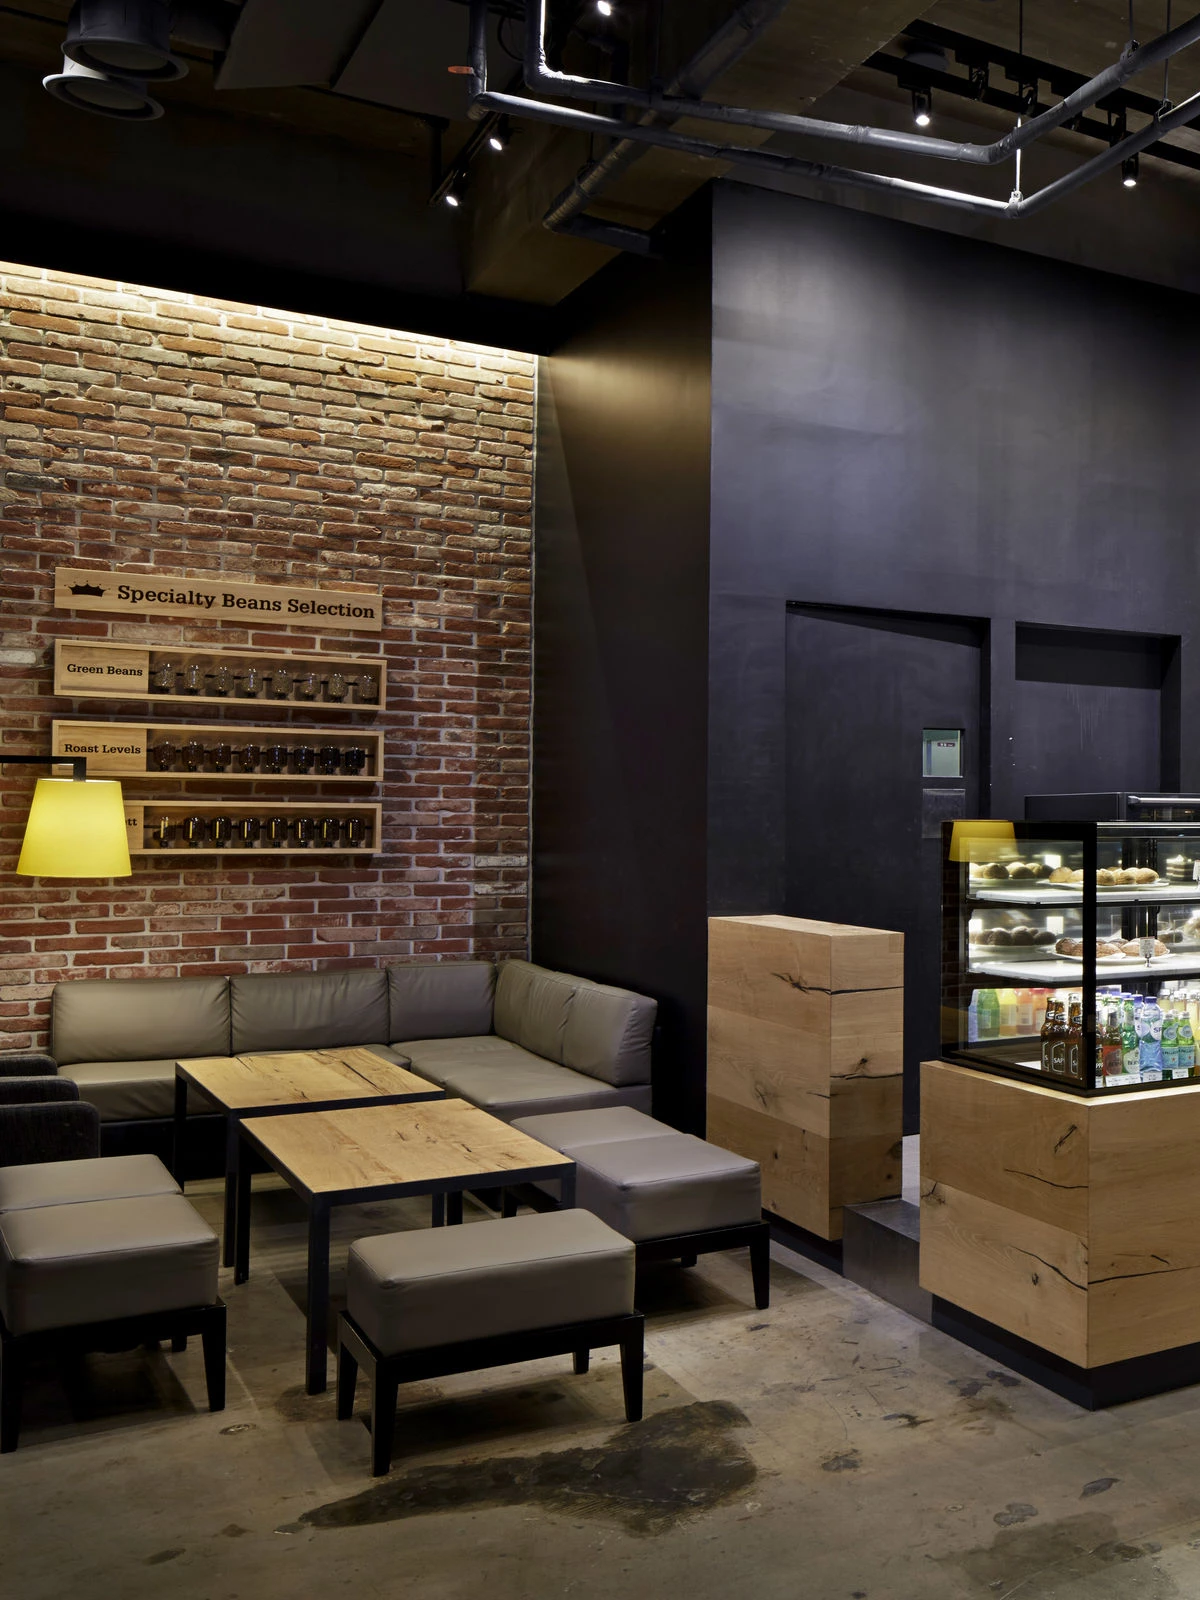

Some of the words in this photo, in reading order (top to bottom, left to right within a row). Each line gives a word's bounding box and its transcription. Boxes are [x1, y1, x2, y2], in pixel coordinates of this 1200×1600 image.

[117, 585, 216, 609] Specialty
[222, 593, 282, 612] Beans
[287, 599, 375, 619] Selection
[66, 664, 103, 674] Green
[107, 666, 143, 676] Beans
[64, 743, 99, 753] Roast
[102, 744, 141, 754] Levels
